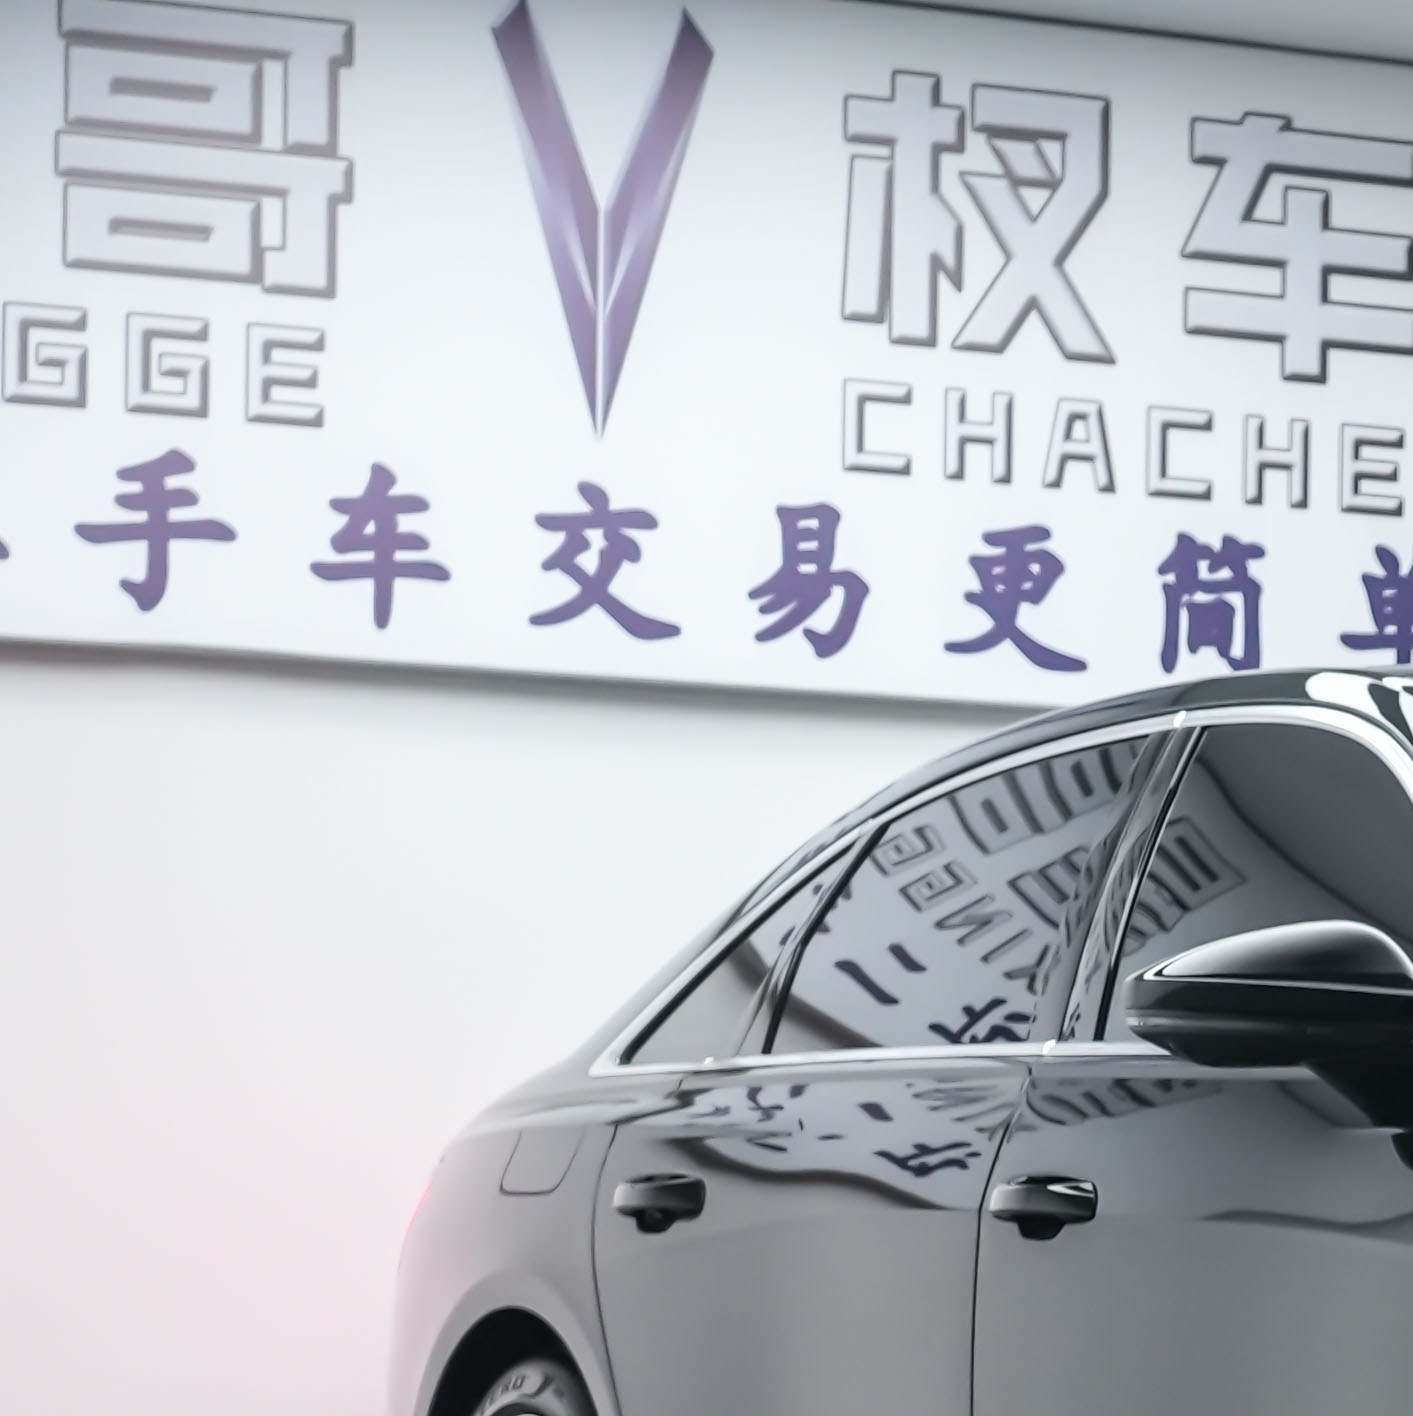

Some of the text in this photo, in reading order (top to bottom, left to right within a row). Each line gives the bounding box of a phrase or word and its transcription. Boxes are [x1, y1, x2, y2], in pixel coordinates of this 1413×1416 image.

[55, 0, 354, 298] 哥
[1, 302, 1404, 517] GGE CHACHE
